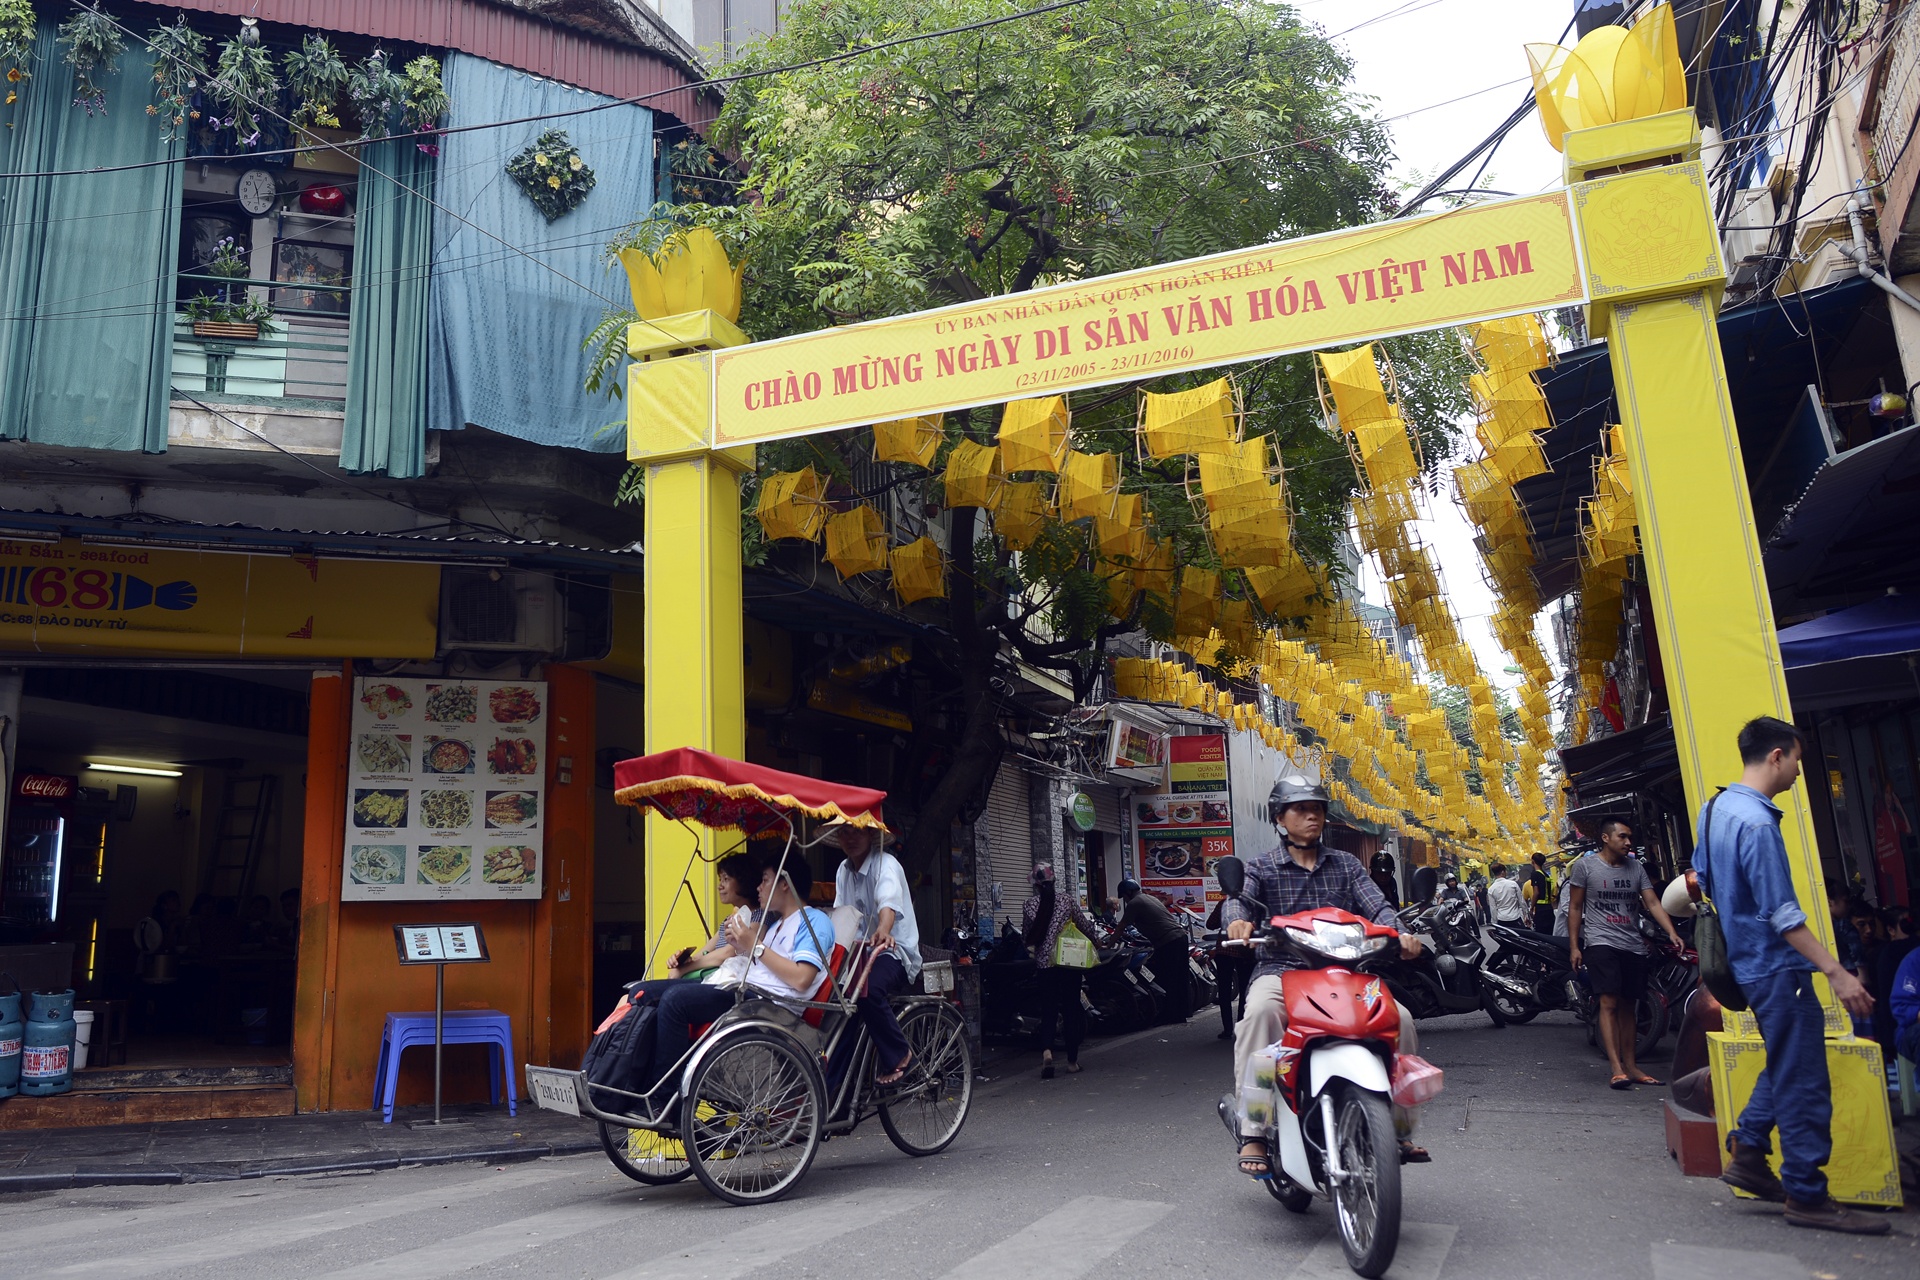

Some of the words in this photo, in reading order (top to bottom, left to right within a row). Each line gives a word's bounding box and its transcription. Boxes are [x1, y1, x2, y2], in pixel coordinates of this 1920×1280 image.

[963, 312, 998, 330] BAN
[1002, 300, 1054, 322] NHÂN
[1058, 292, 1096, 312] DÂN
[1101, 282, 1154, 304] QUẬN
[1160, 270, 1216, 292] HOÀN
[744, 369, 822, 411] CHÀO
[832, 355, 922, 396] MỪNG
[936, 334, 1022, 378] NGÀY
[1034, 325, 1070, 360] DI
[1084, 308, 1150, 352] SẢN
[1161, 294, 1234, 336] VĂN
[1246, 274, 1327, 322] HÓA
[1336, 259, 1427, 306] VIỆT
[1440, 240, 1534, 288] NAM
[1016, 362, 1096, 388] (23/11/2005
[1110, 346, 1194, 372] 23/11/2016)
[30, 542, 64, 560] Sản
[80, 550, 149, 564] seafood
[30, 567, 109, 610] 68
[39, 613, 70, 626] ĐÀO
[74, 618, 104, 628] DUY
[108, 618, 128, 630] TỪ
[1207, 840, 1228, 852] 35K
[1597, 891, 1637, 899] THINKING
[1604, 880, 1607, 888] I
[1614, 880, 1631, 888] WAS
